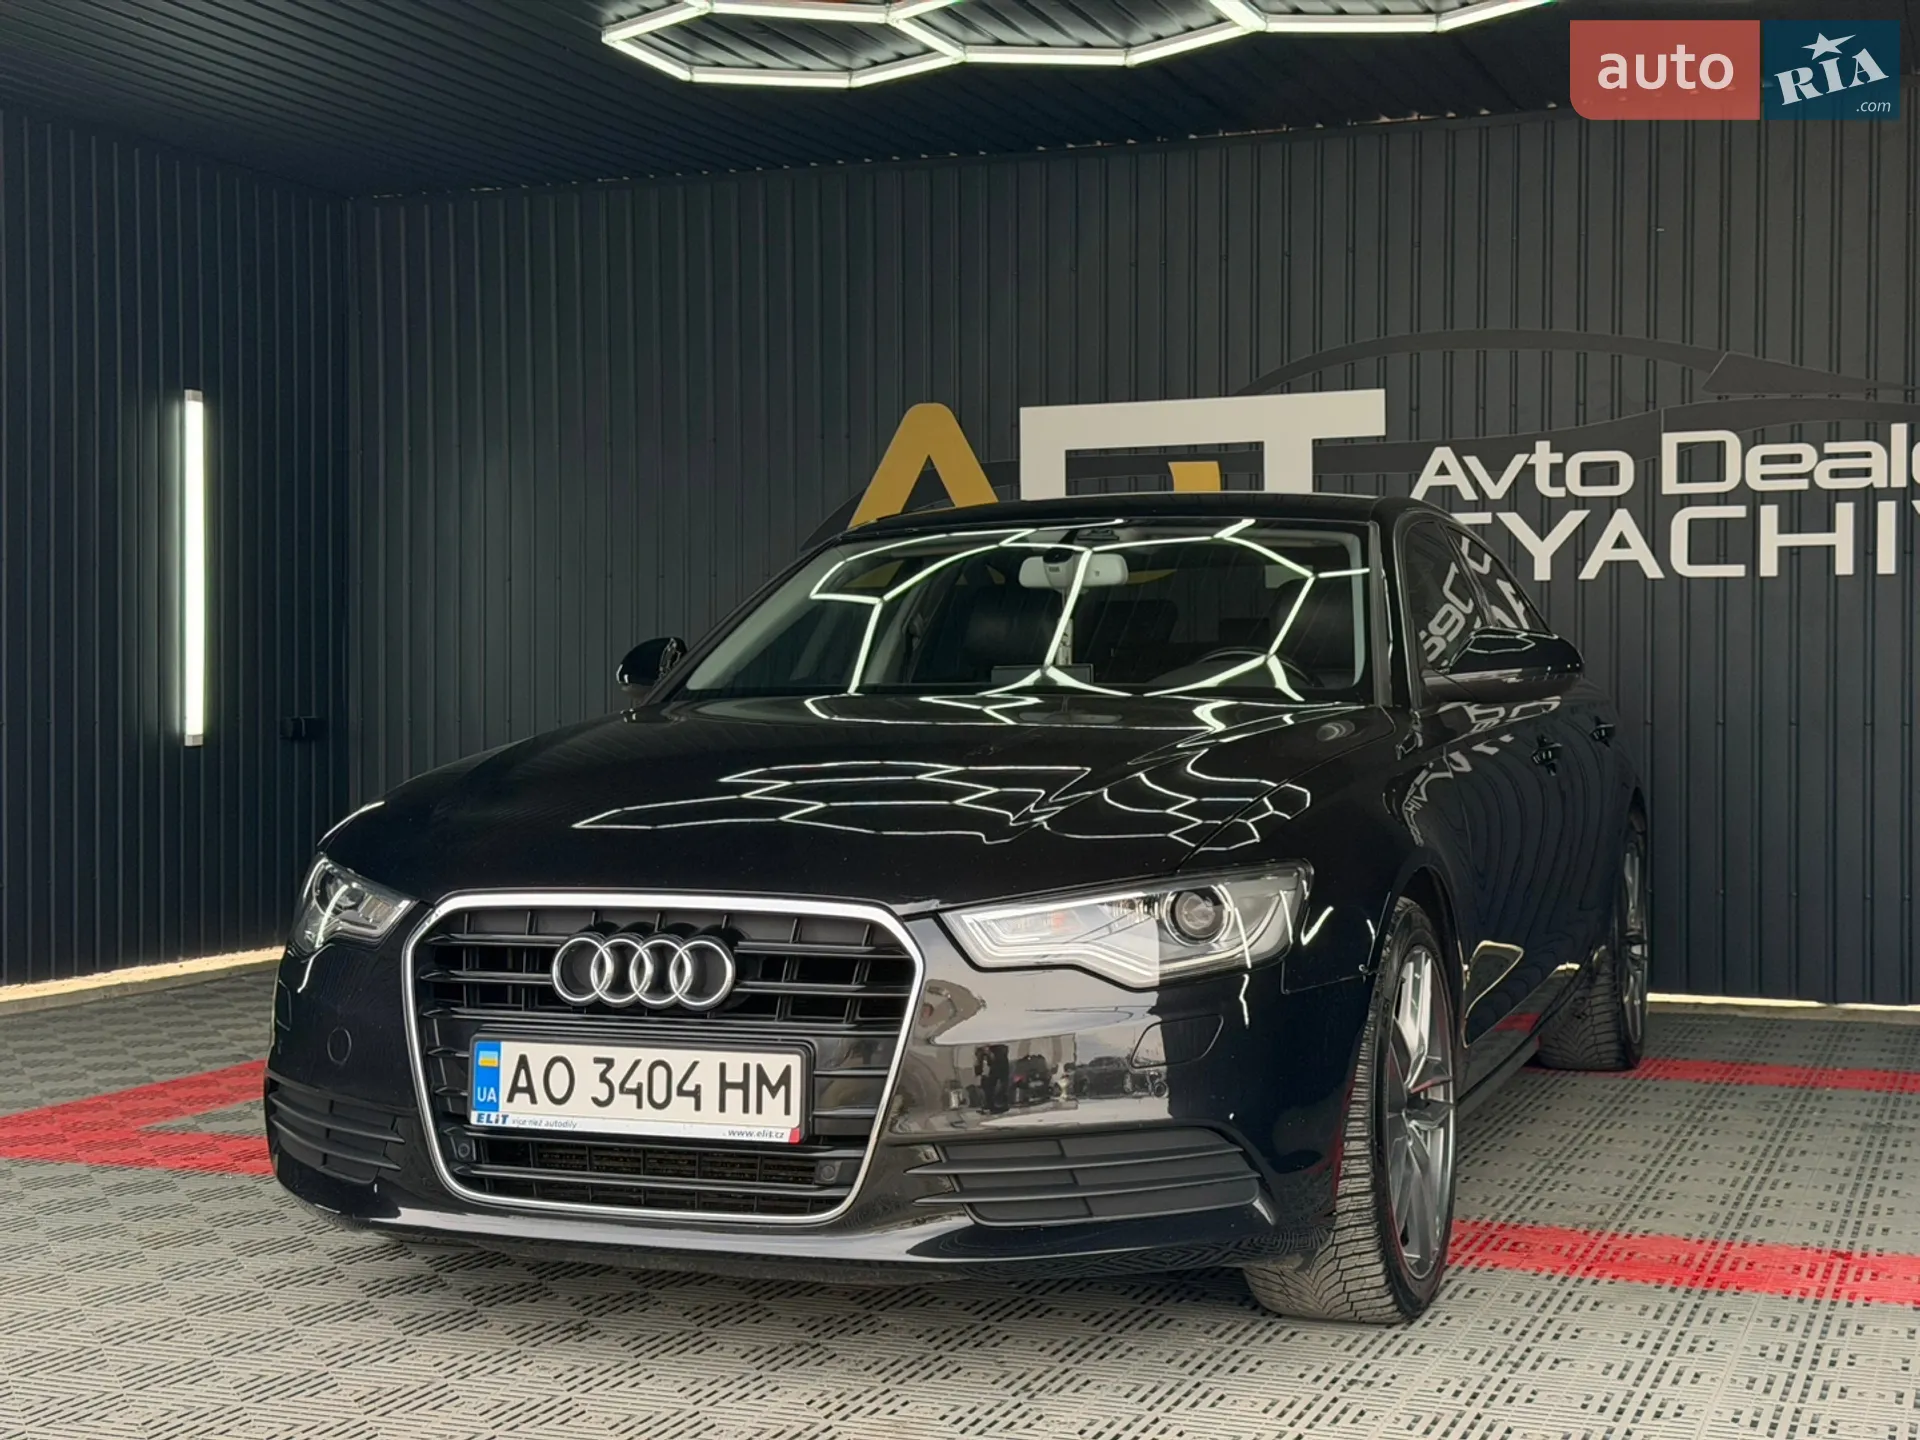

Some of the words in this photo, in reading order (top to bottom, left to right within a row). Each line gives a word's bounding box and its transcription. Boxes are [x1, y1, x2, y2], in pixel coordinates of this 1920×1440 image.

[1411, 440, 1635, 501] Avto
[1662, 423, 1920, 495] Deal
[1450, 501, 1920, 582] YACHI
[477, 1087, 497, 1103] UA
[506, 1054, 576, 1106] AO
[591, 1057, 702, 1112] 3404
[718, 1062, 792, 1117] HM
